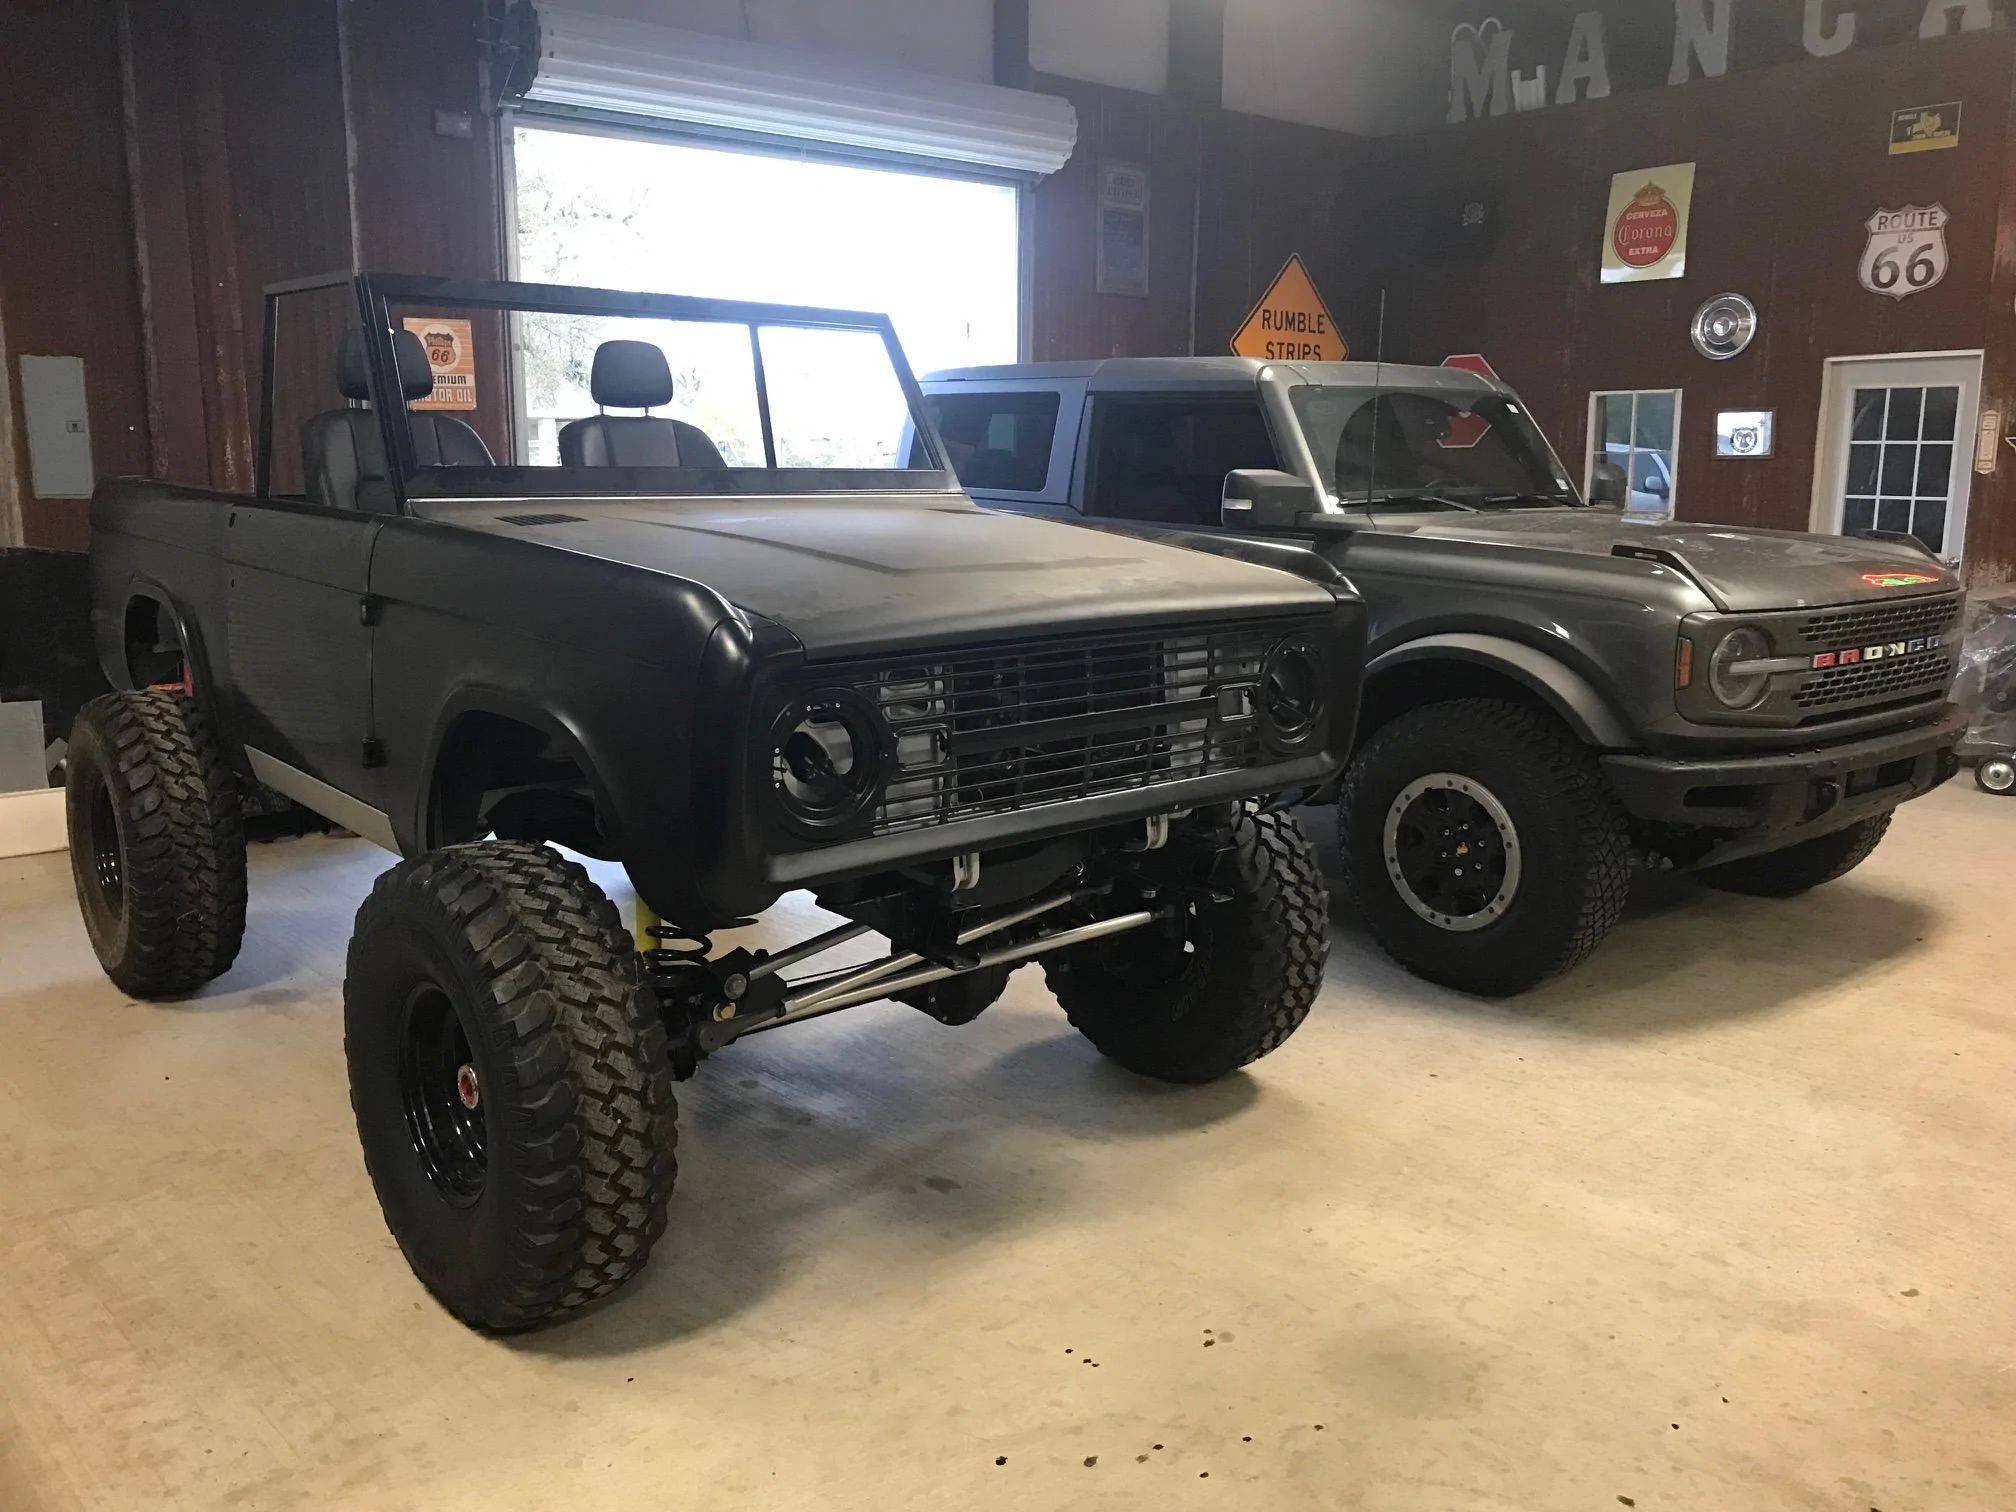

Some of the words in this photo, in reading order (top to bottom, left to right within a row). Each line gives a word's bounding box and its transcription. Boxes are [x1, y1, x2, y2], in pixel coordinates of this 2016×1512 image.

[1626, 209, 1668, 220] CERVEZA
[1877, 210, 1938, 231] ROUTE
[1618, 224, 1672, 245] Corona
[1897, 232, 1914, 244] US
[1628, 246, 1658, 256] EXTRA
[1871, 243, 1935, 289] 66
[1261, 309, 1325, 334] RUMBLE
[432, 349, 450, 362] 66
[1265, 341, 1321, 361] STRIPS
[433, 375, 466, 384] EMIUM
[459, 389, 472, 402] OIL
